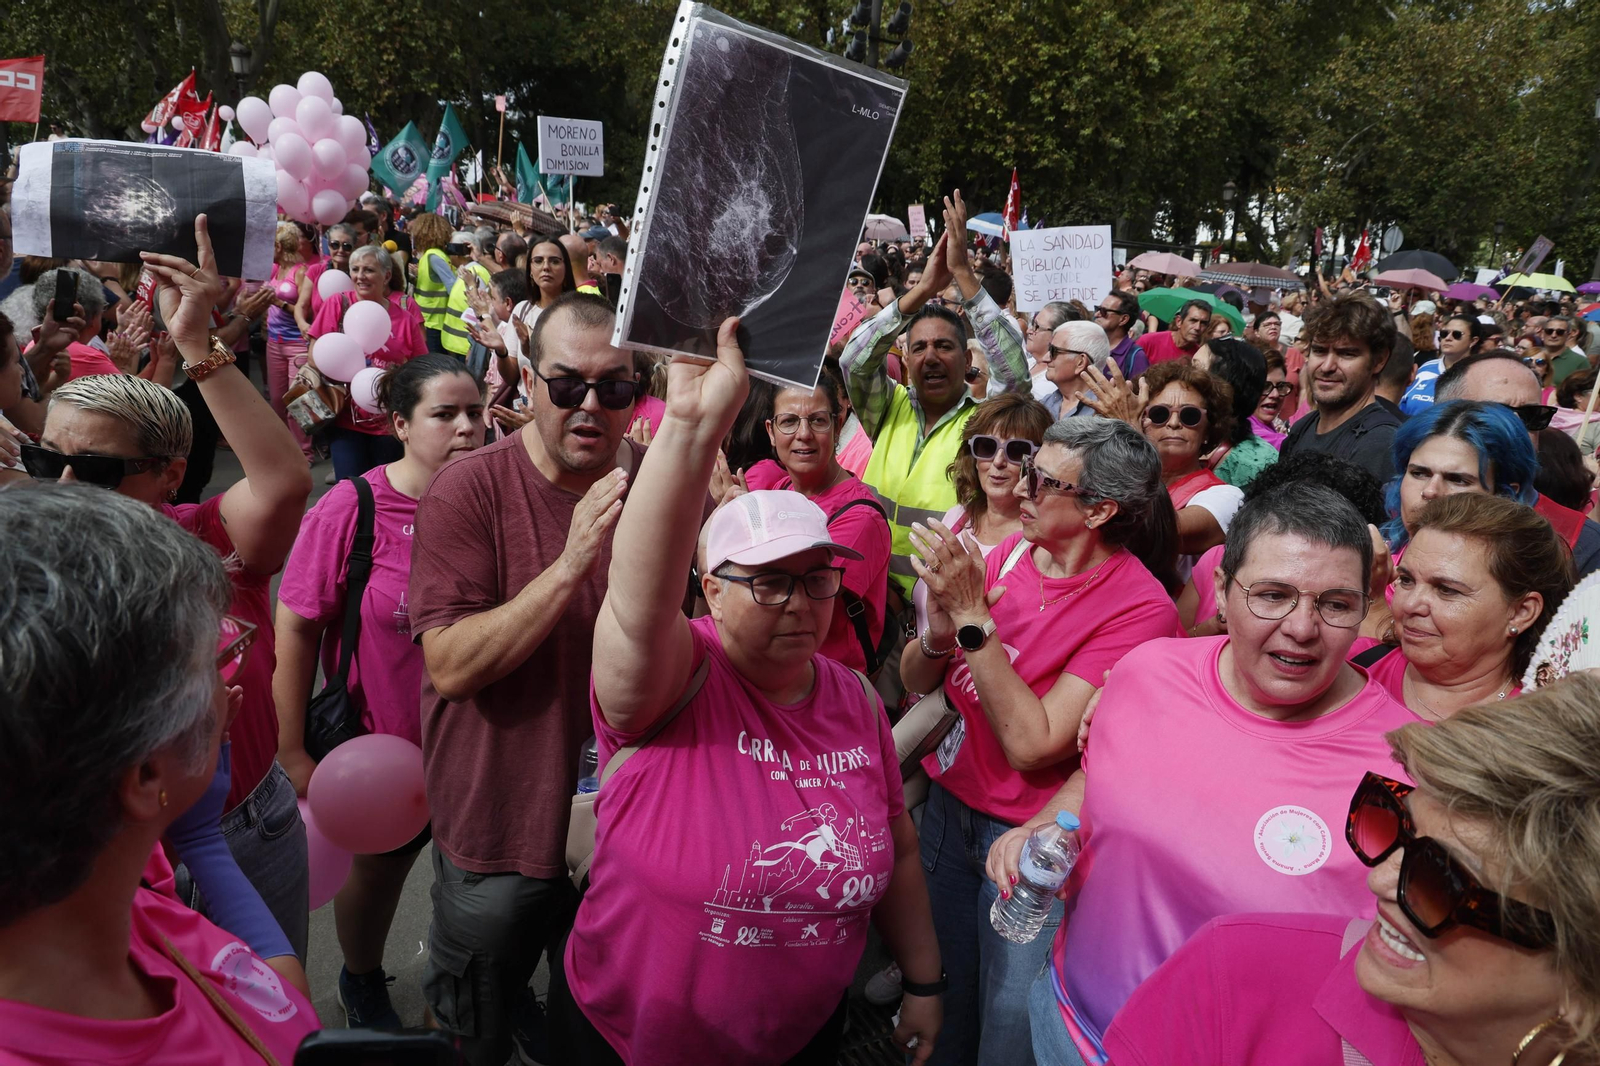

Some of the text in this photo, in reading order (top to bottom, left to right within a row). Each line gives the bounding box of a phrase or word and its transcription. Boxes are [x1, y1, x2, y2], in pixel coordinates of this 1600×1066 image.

[851, 103, 880, 120] L-MLO
[548, 124, 597, 141] MORENO
[561, 143, 600, 157] BONILLA
[546, 158, 590, 171] DIMISION
[1019, 233, 1105, 252] LA SANIDAD
[1020, 255, 1091, 272] PÚBLICA NO
[1022, 272, 1082, 287] SE VENDE
[1024, 287, 1099, 303] SE DEFIENDE
[800, 760, 812, 771] DE
[795, 777, 822, 789] CÁNCER
[1289, 808, 1313, 821] Mujeres
[1312, 819, 1322, 830] con
